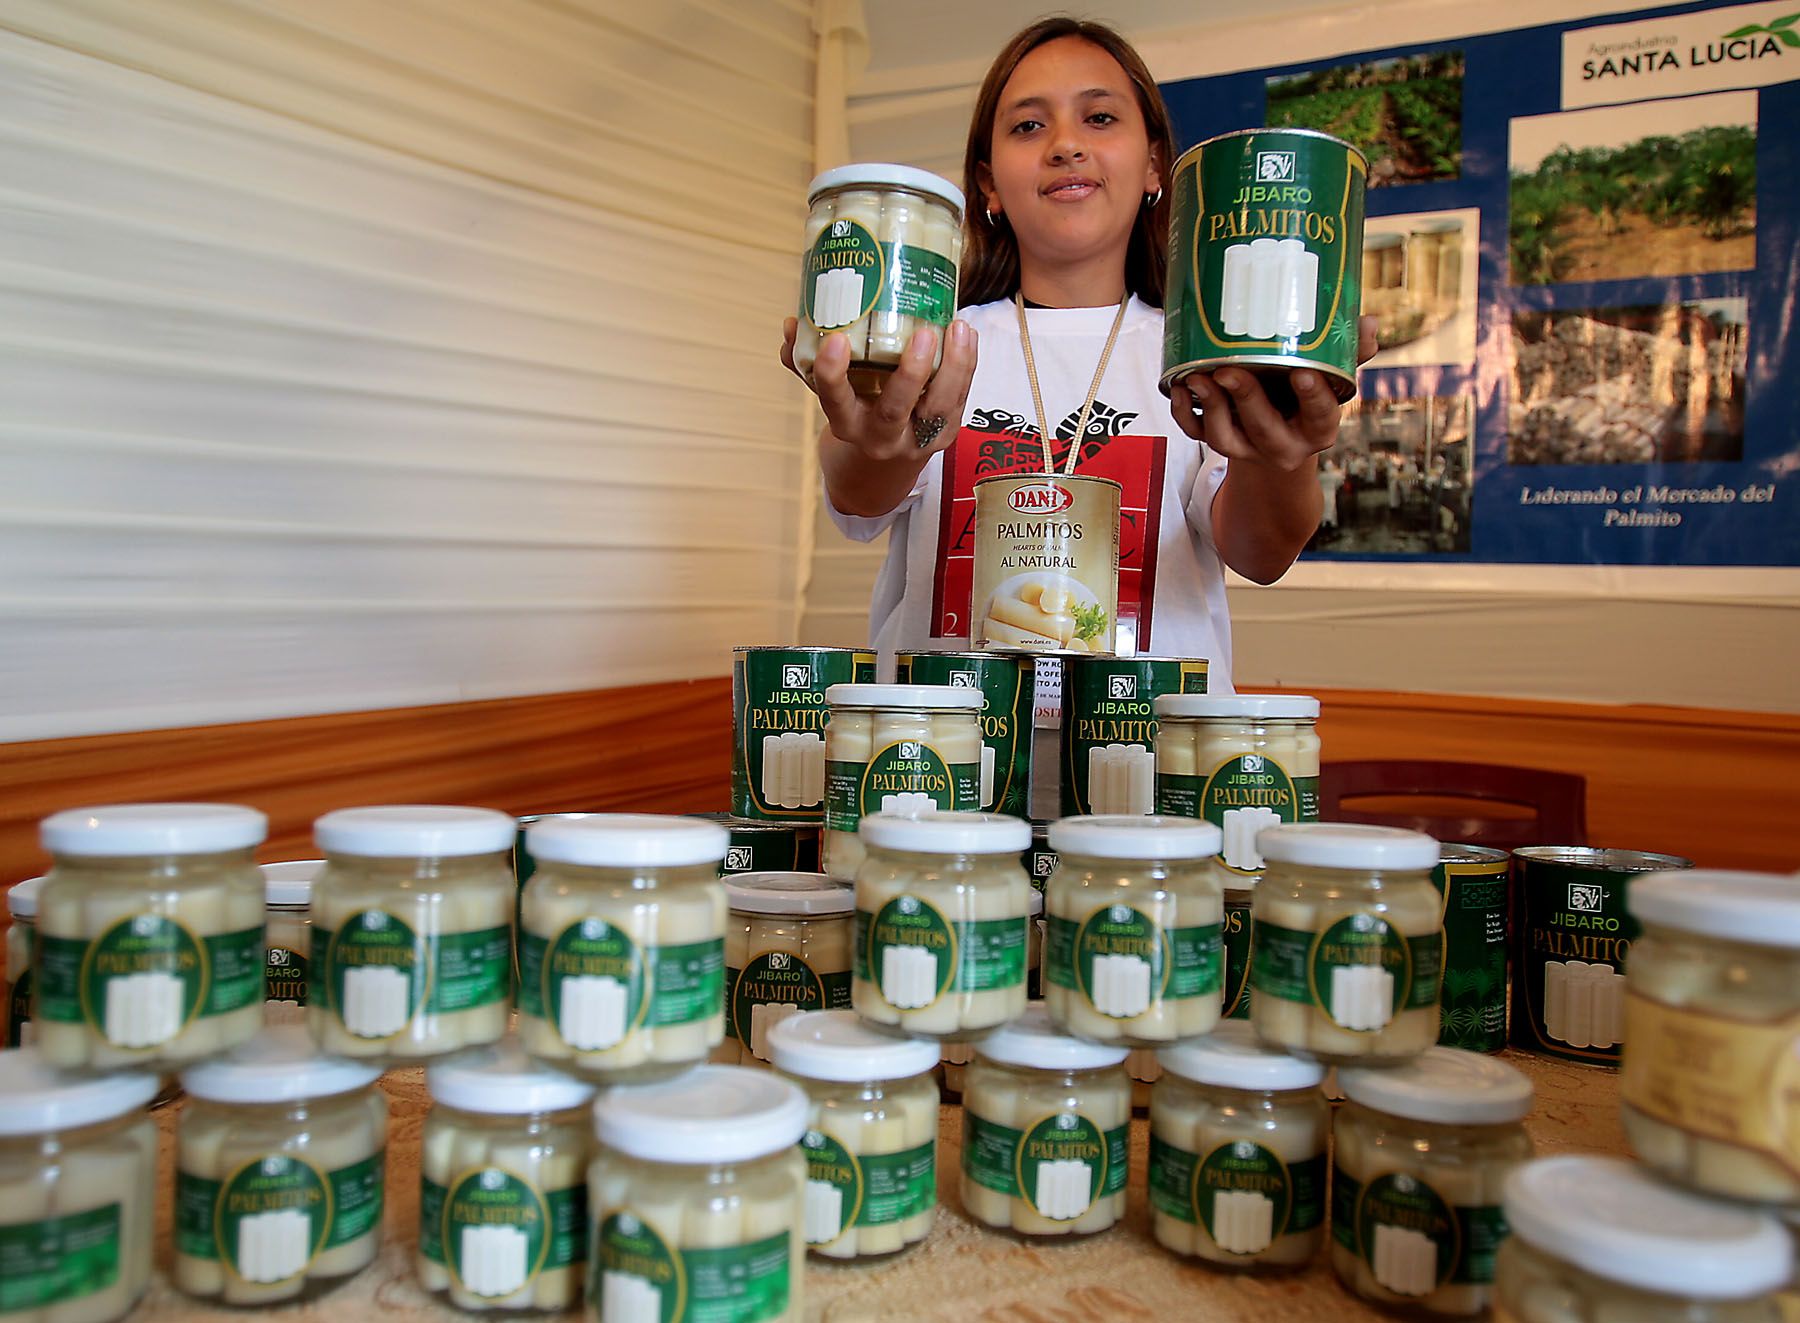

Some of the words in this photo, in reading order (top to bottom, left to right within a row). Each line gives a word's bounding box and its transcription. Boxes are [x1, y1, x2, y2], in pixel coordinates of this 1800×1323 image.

[1583, 51, 1680, 80] SANTA
[1690, 37, 1782, 67] LUCIA
[1232, 186, 1313, 204] JIBARO
[1208, 208, 1336, 245] PALMITOS
[821, 237, 861, 251] JIBARO
[812, 250, 875, 272] PALMITOS
[1520, 486, 1618, 505] Liderando
[1622, 486, 1642, 503] el
[1646, 485, 1736, 504] Mercado
[1740, 484, 1776, 502] del
[1603, 508, 1682, 527] Palmito
[997, 522, 1083, 540] PALMITOS
[1000, 556, 1015, 568] AL
[1018, 556, 1077, 568] NATURAL
[767, 691, 824, 704] JIBARO
[1093, 702, 1151, 715] JIBARO
[752, 708, 831, 731] PALMITO
[1078, 719, 1160, 742] PALMITO
[886, 761, 931, 771] JIBARO
[872, 773, 946, 791] PALMITOS
[1228, 774, 1275, 785] JIBARO
[1213, 787, 1289, 806] PALMITOS
[1550, 912, 1620, 932] JIBARO
[1534, 928, 1630, 963] PALMITO
[266, 967, 301, 978] BARO
[756, 970, 800, 982] JIBARO
[744, 981, 816, 1002] PALMITOS
